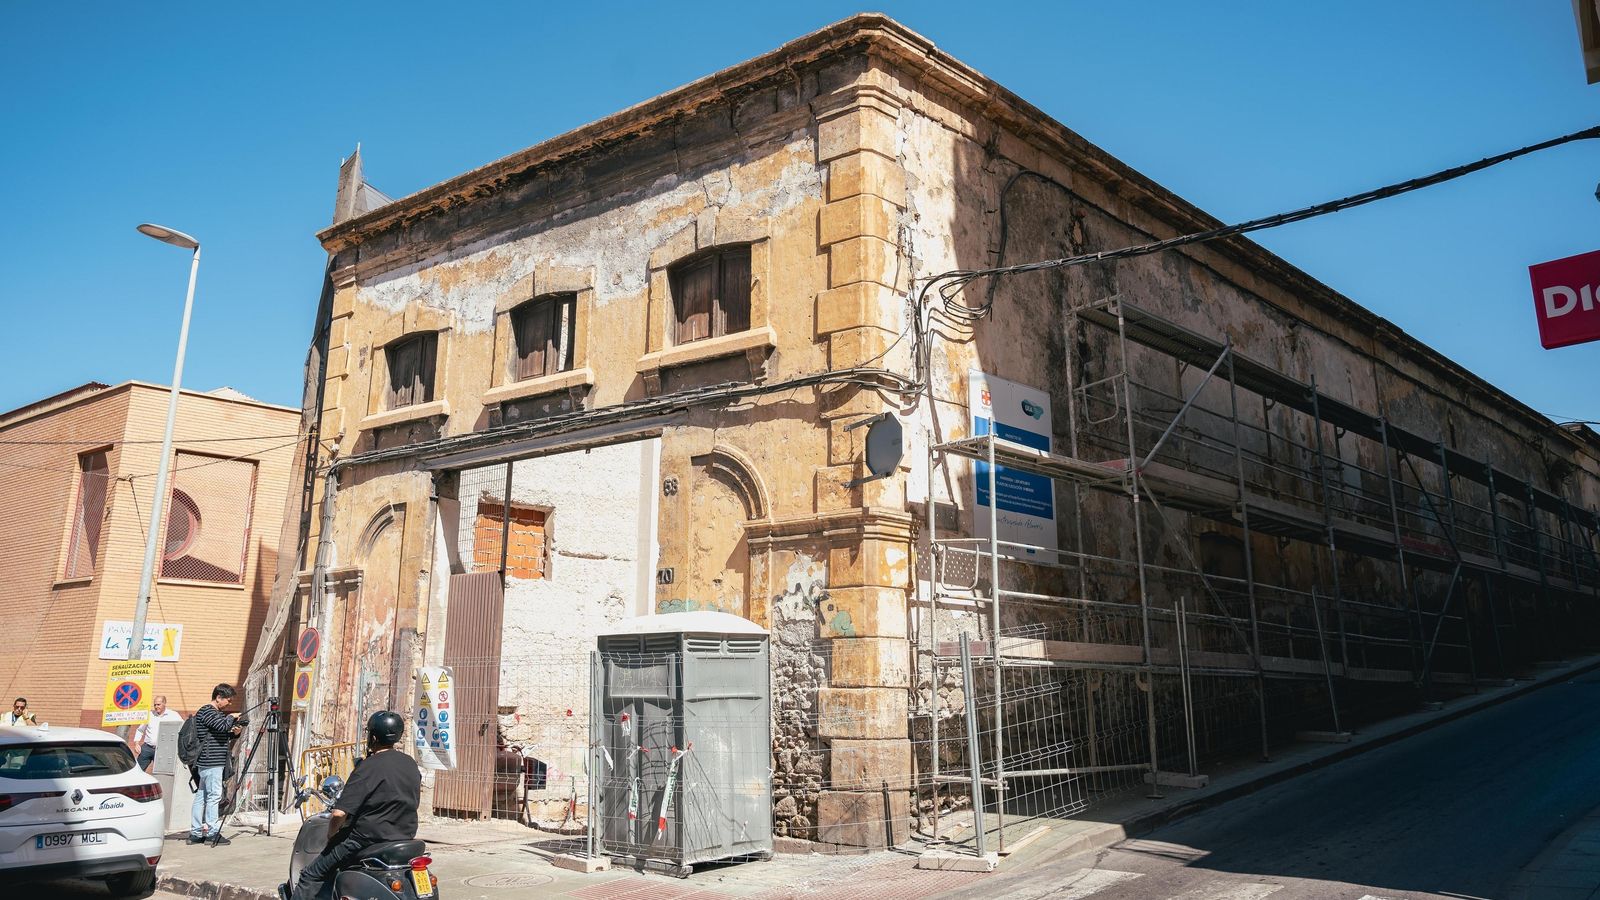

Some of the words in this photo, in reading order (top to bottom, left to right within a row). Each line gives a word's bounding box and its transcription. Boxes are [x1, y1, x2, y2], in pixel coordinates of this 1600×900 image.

[108, 625, 160, 635] PANARIA
[105, 637, 120, 649] La
[98, 802, 124, 810] albaida
[44, 834, 74, 847] 0997
[81, 832, 102, 844] MGL
